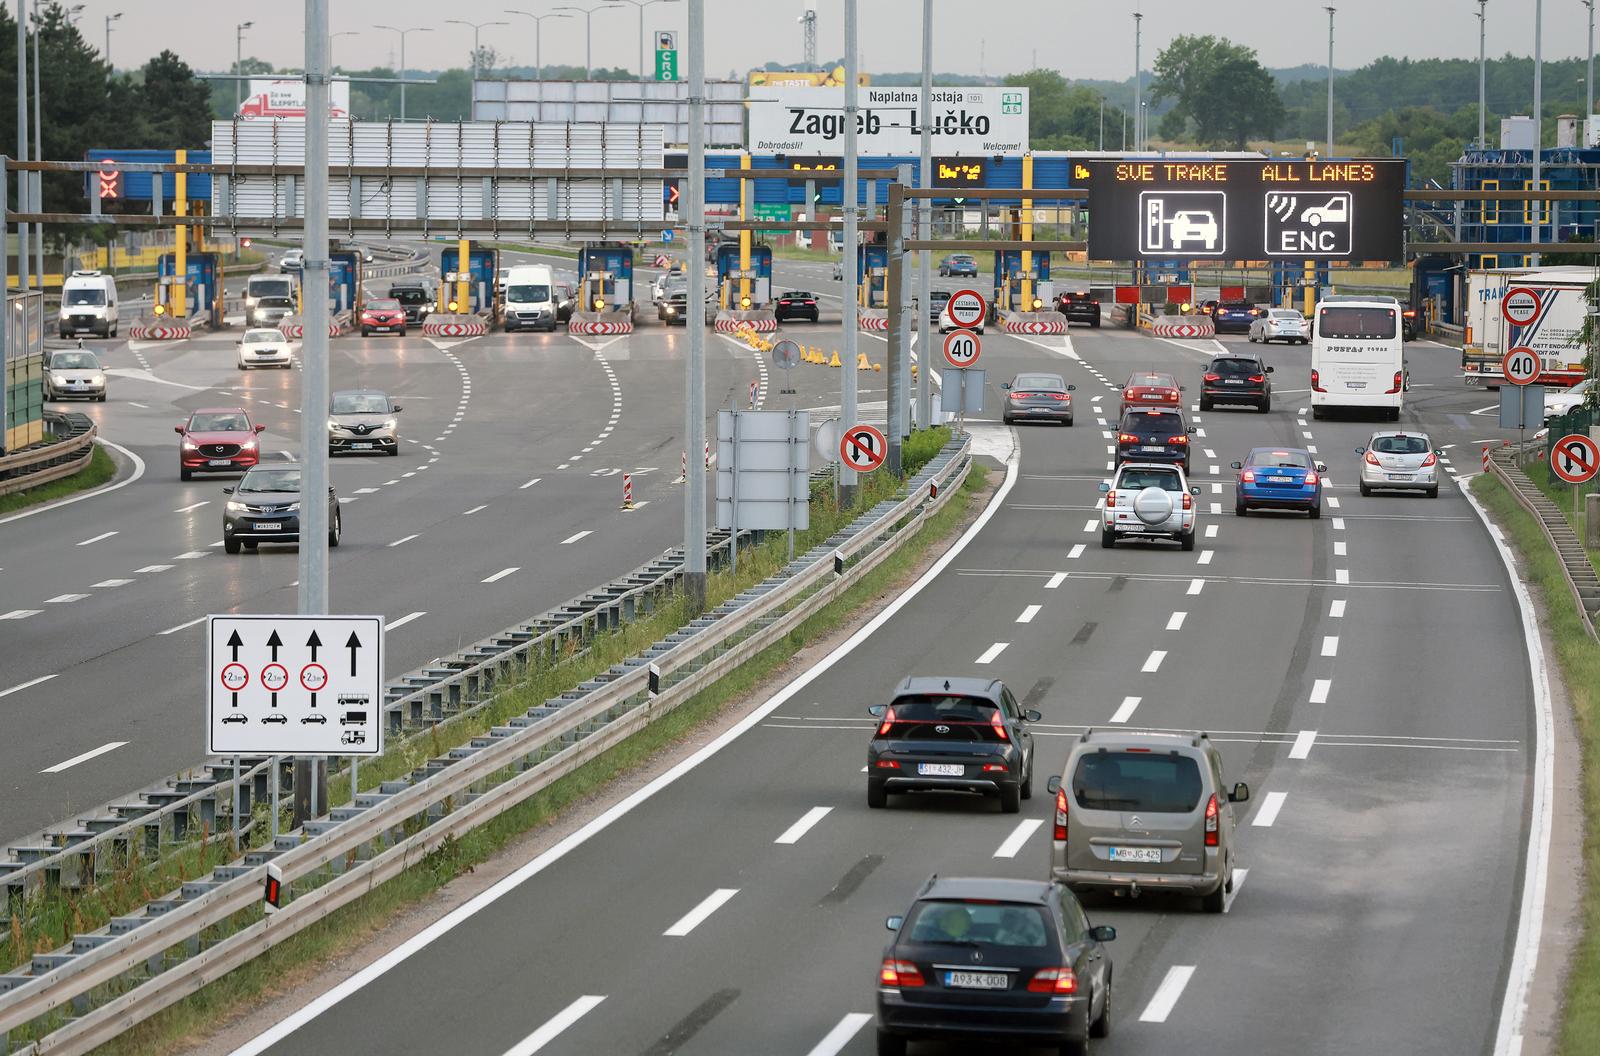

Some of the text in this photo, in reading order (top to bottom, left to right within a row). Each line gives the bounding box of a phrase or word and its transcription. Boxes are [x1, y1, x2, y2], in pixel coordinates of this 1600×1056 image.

[869, 91, 963, 104] Naplatna ostaja
[910, 109, 990, 135] Lučko
[983, 142, 1021, 151] Welcome!
[1116, 164, 1228, 181] SVE TRAKE
[1262, 164, 1375, 181] ALL LANES
[1281, 230, 1336, 251] ENC
[952, 339, 973, 357] 40
[1510, 357, 1533, 375] 40
